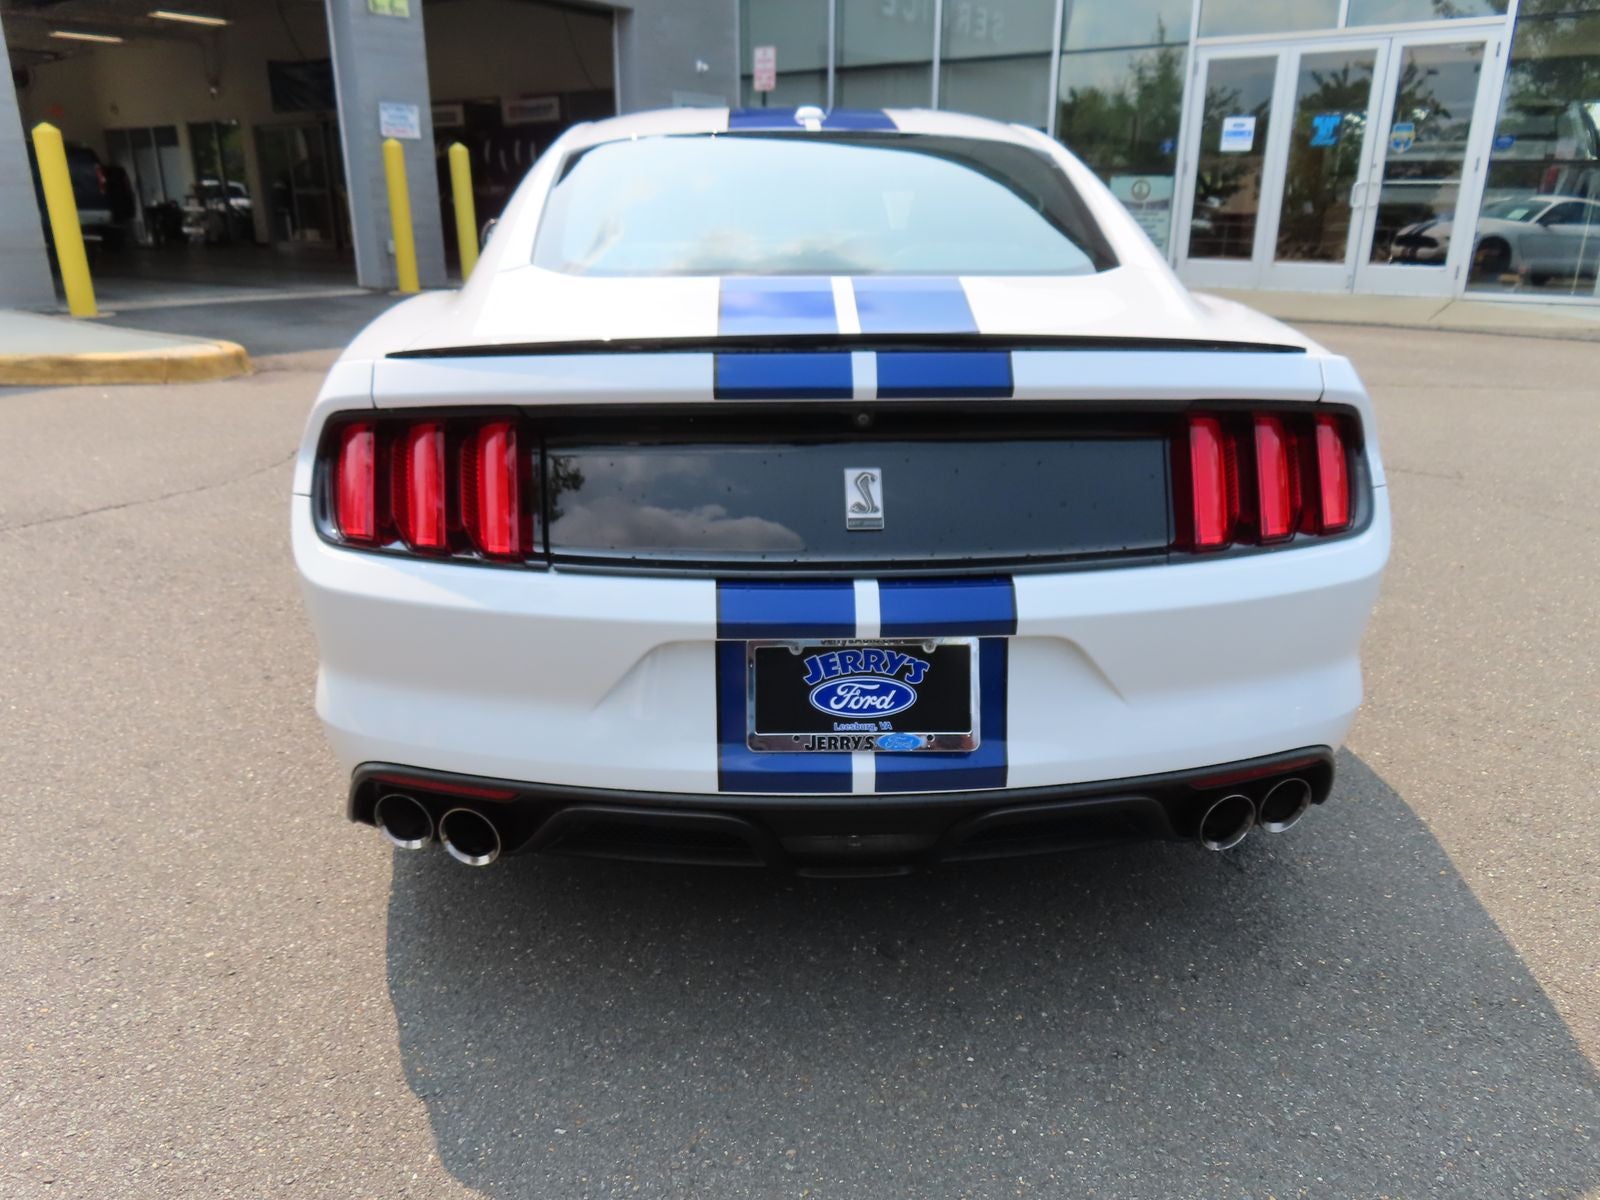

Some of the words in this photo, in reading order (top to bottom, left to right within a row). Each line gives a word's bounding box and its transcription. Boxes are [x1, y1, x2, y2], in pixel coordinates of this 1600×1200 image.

[803, 648, 930, 685] JERRY'S
[830, 682, 896, 711] Ford
[879, 721, 893, 731] VA
